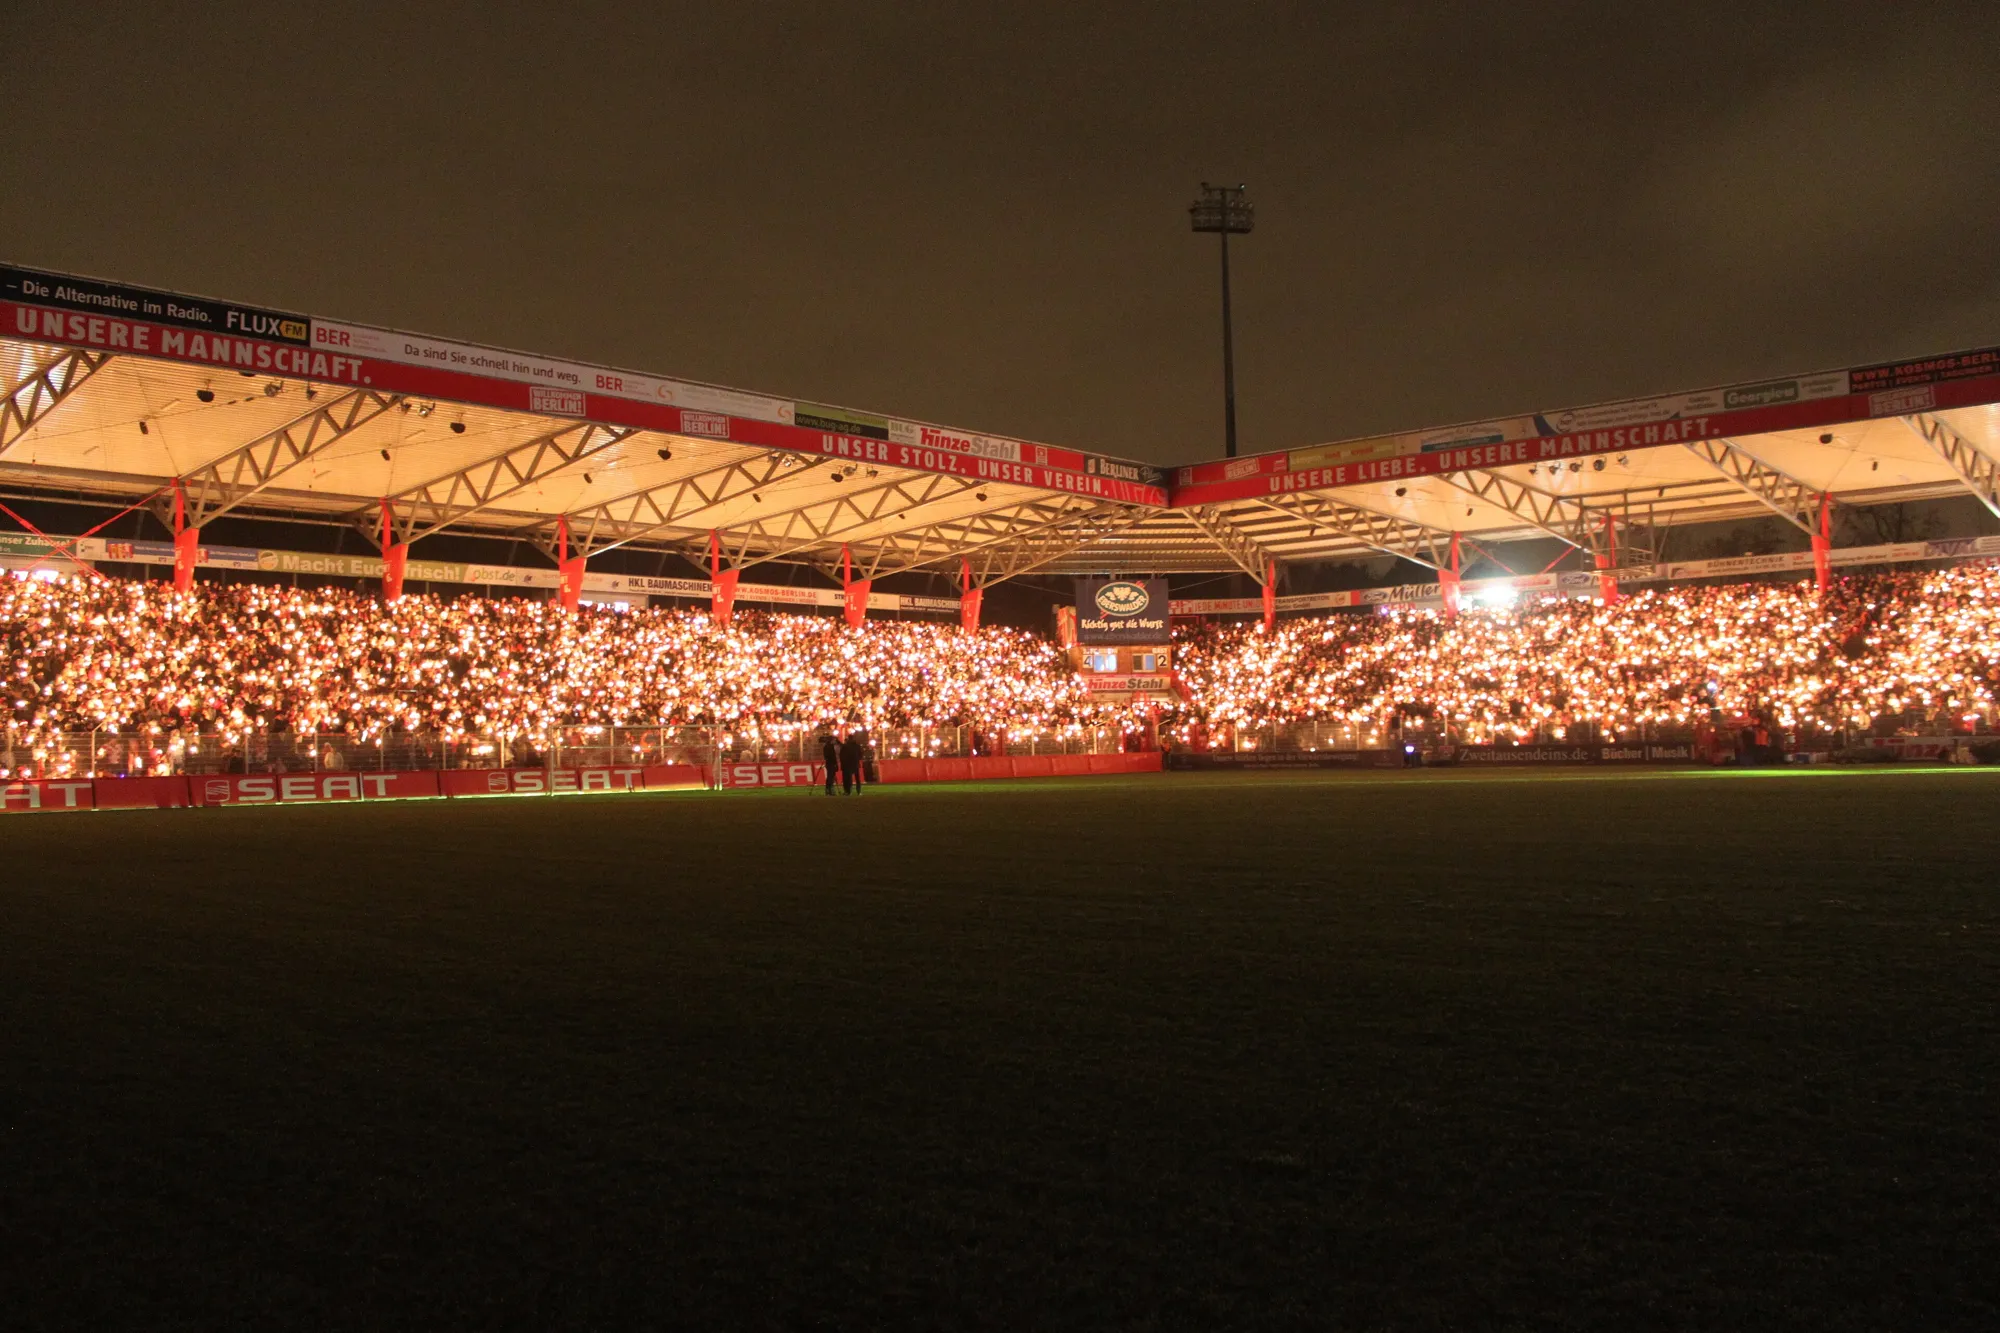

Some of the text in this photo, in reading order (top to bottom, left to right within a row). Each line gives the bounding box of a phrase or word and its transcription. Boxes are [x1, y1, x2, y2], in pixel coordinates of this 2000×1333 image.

[23, 280, 304, 337] Die Alternative im Radio. FLUX FM
[16, 307, 150, 350] UNSERE
[161, 331, 371, 384] MANNSCHAFT.
[316, 327, 350, 347] BER
[404, 343, 582, 386] Da sind Sie schnell hin und weg.
[596, 374, 623, 391] BER
[533, 387, 582, 401] WILLKOMMEN
[533, 396, 582, 414] BERLIN!
[683, 420, 727, 436] BERLIN!
[796, 414, 861, 434] www.bug-ag.de
[1270, 418, 1720, 492] UNSERE LIEBE. UNSERE MANNSCHAFT.
[823, 434, 888, 461] UNSER
[900, 447, 966, 474] STOLZ.
[978, 459, 1033, 484] UNSER
[1044, 470, 1109, 496] VEREIN.
[1100, 458, 1139, 480] BERLINER
[0, 536, 23, 545] nser
[283, 555, 344, 573] Macht
[351, 560, 387, 575] Euc
[1707, 555, 1785, 568] BÜHNENTECHNIK
[474, 567, 515, 582] obst.de
[629, 578, 645, 587] HKL
[648, 579, 713, 592] BAUMASCHINEN
[1389, 584, 1441, 602] Müller
[900, 597, 913, 606] HKL
[1098, 595, 1147, 612] EBERSWALDER
[1081, 618, 1164, 631] Richtig gut die Wurst
[1158, 654, 1167, 667] 2
[1460, 745, 1689, 763] Zweitausendeins.de Bücher Musik
[238, 774, 397, 802] SEAT
[514, 769, 641, 792] SEAT
